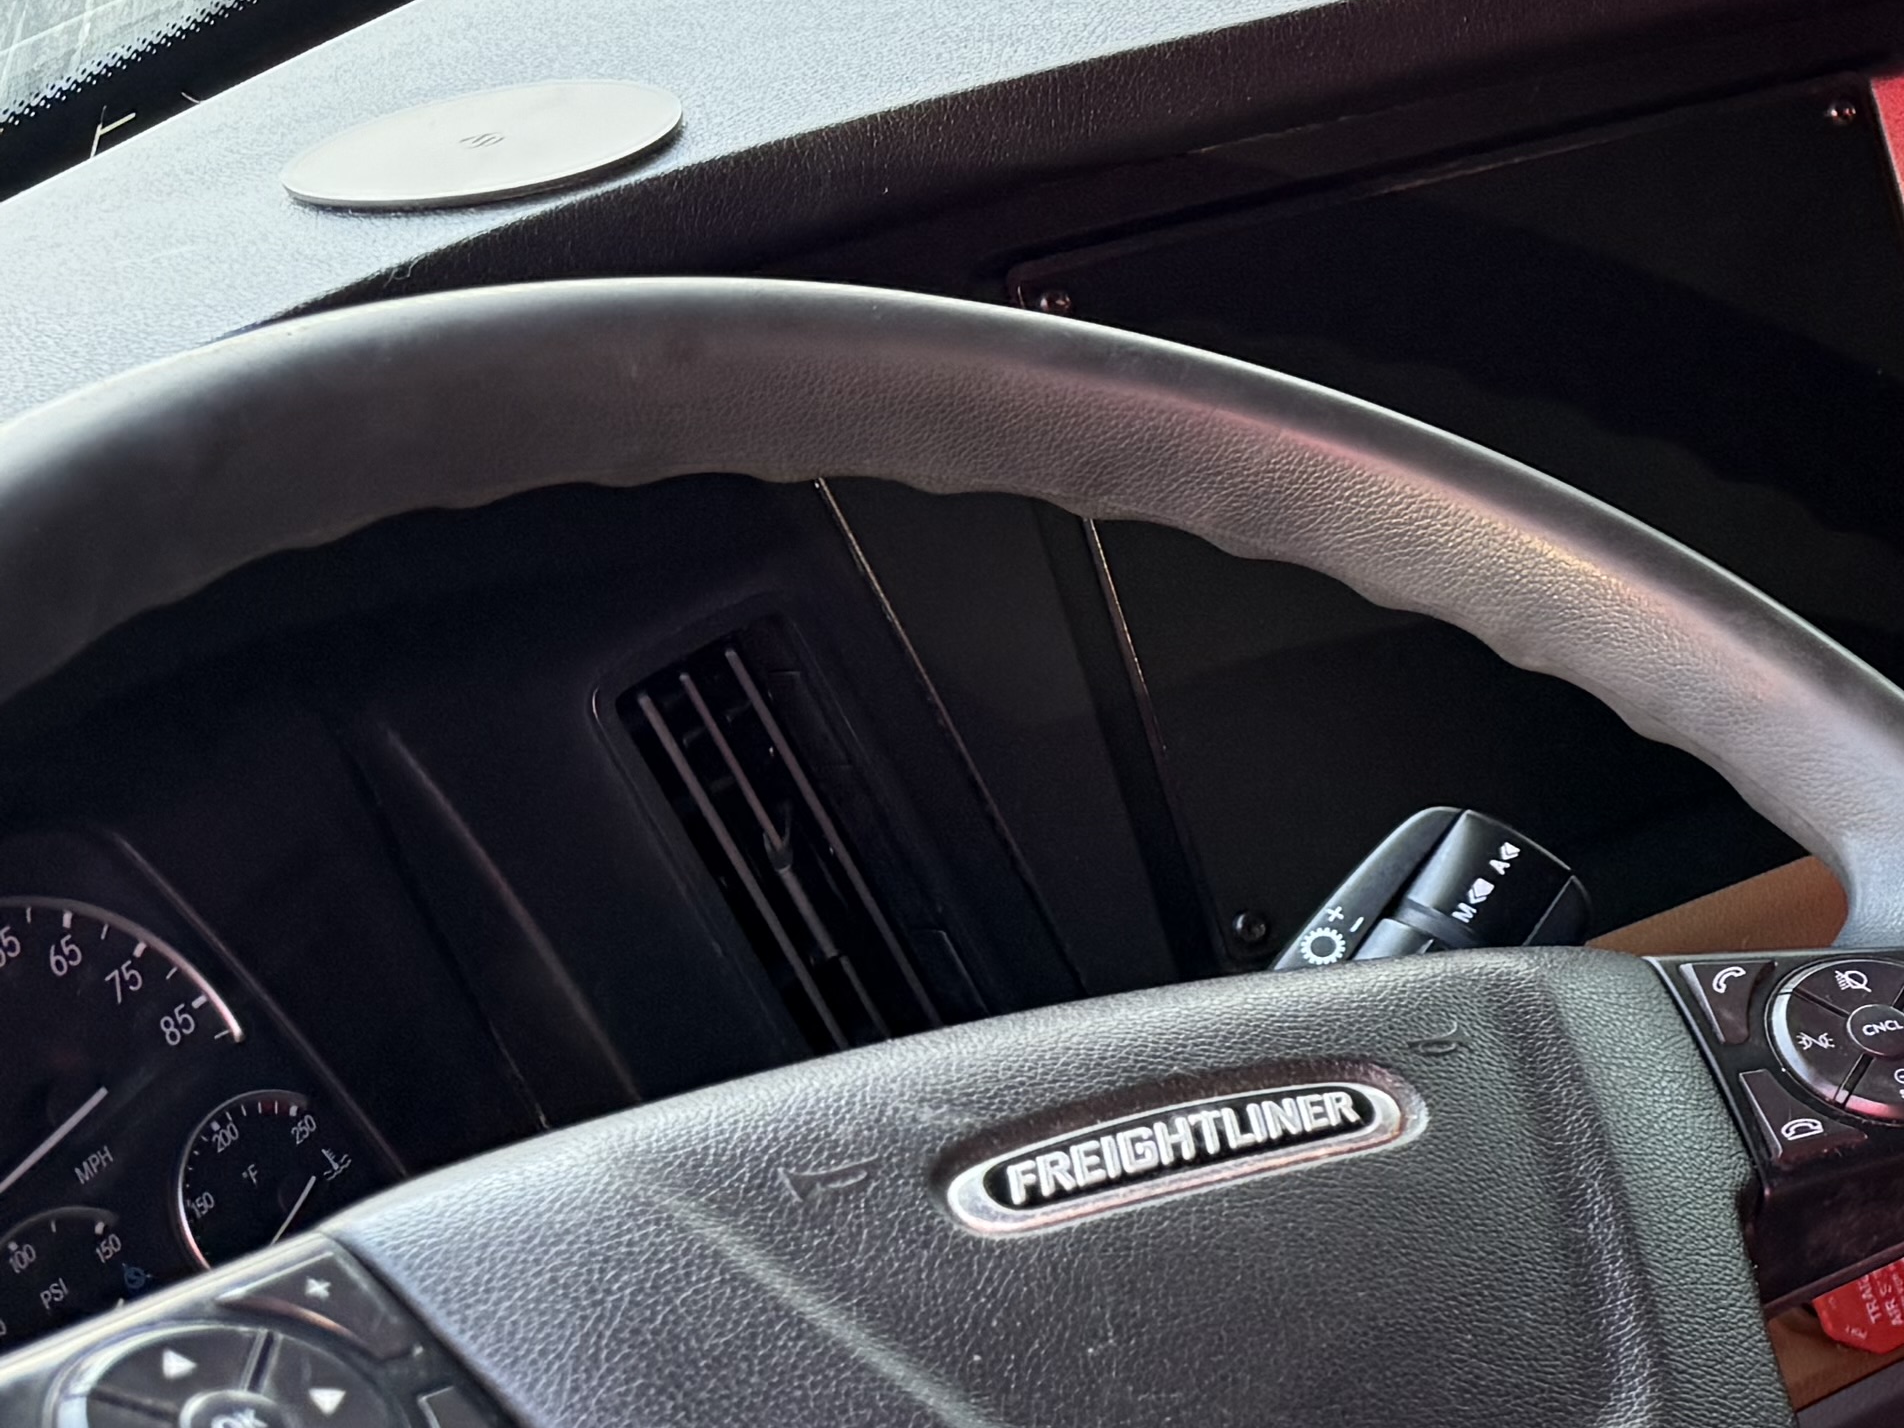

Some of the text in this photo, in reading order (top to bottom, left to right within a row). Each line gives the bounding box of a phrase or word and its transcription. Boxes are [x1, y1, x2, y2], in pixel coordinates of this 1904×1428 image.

[1489, 859, 1511, 876] A
[1451, 902, 1477, 924] M
[50, 934, 82, 977] 65
[104, 960, 143, 1005] 75
[160, 1003, 195, 1046] 85
[1862, 1019, 1904, 1037] CNCL
[211, 1122, 239, 1154] 200
[290, 1114, 317, 1145] 250
[1005, 1090, 1363, 1206] FREIGHTLINER
[74, 1145, 114, 1185] MPH
[190, 1191, 215, 1219] 150
[9, 1243, 37, 1275] 100
[95, 1233, 122, 1264] 150
[40, 1277, 69, 1310] PSI
